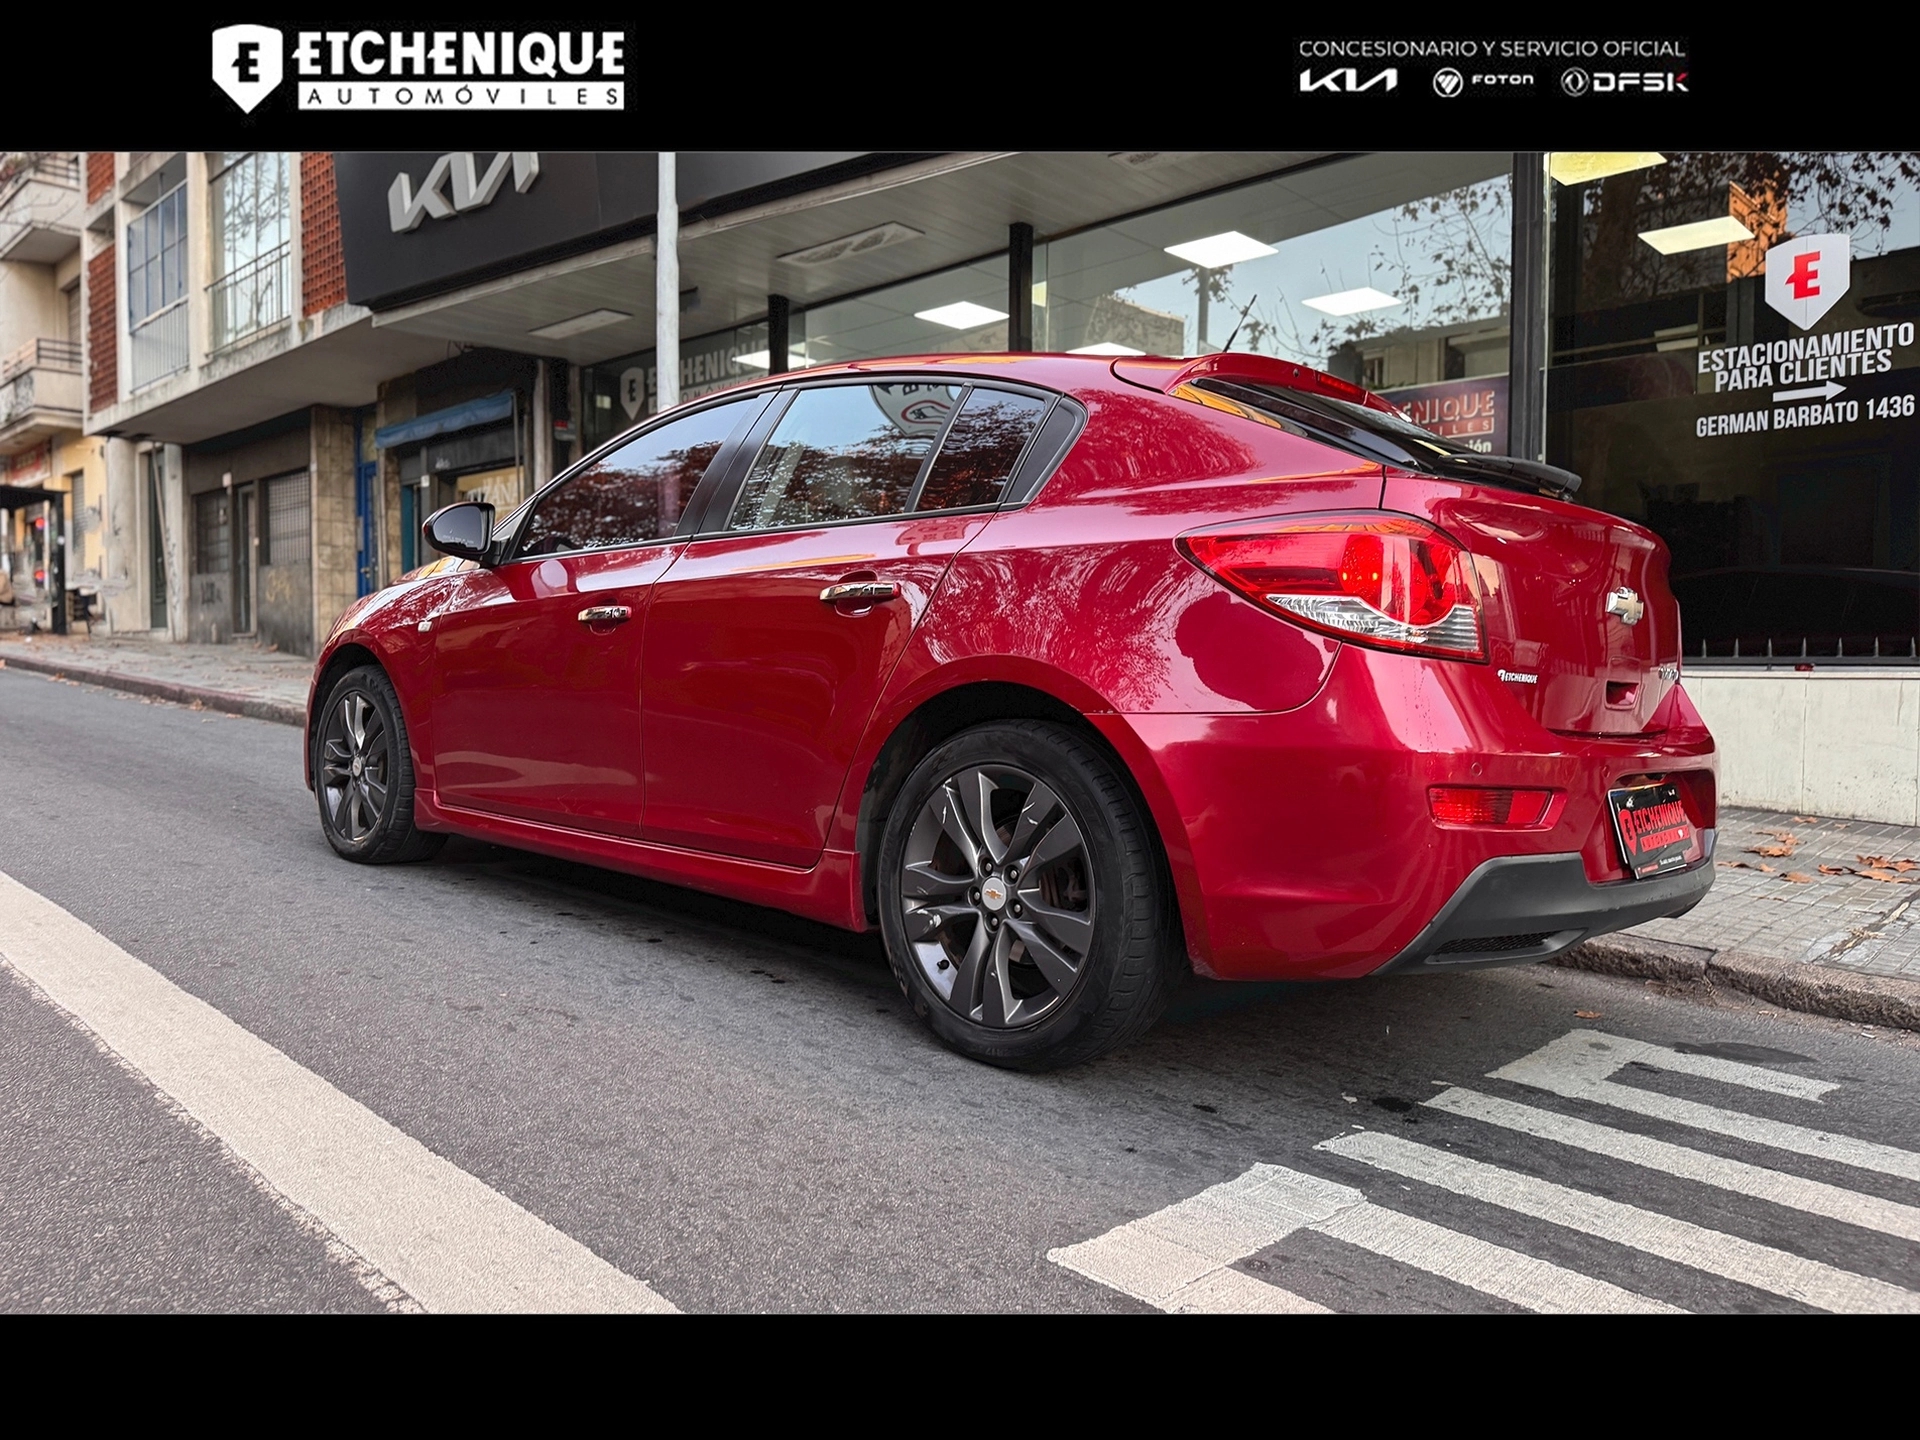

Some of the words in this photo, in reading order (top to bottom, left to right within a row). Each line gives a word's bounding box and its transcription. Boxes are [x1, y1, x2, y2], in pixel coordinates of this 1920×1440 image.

[1698, 321, 1915, 374] ESTACIONAMIENTO
[1715, 365, 1774, 393] PARA
[1780, 349, 1892, 385] CLIENTES
[1696, 410, 1769, 438] GERMAN
[1774, 401, 1859, 430] BARBATO
[1867, 394, 1915, 420] 1436
